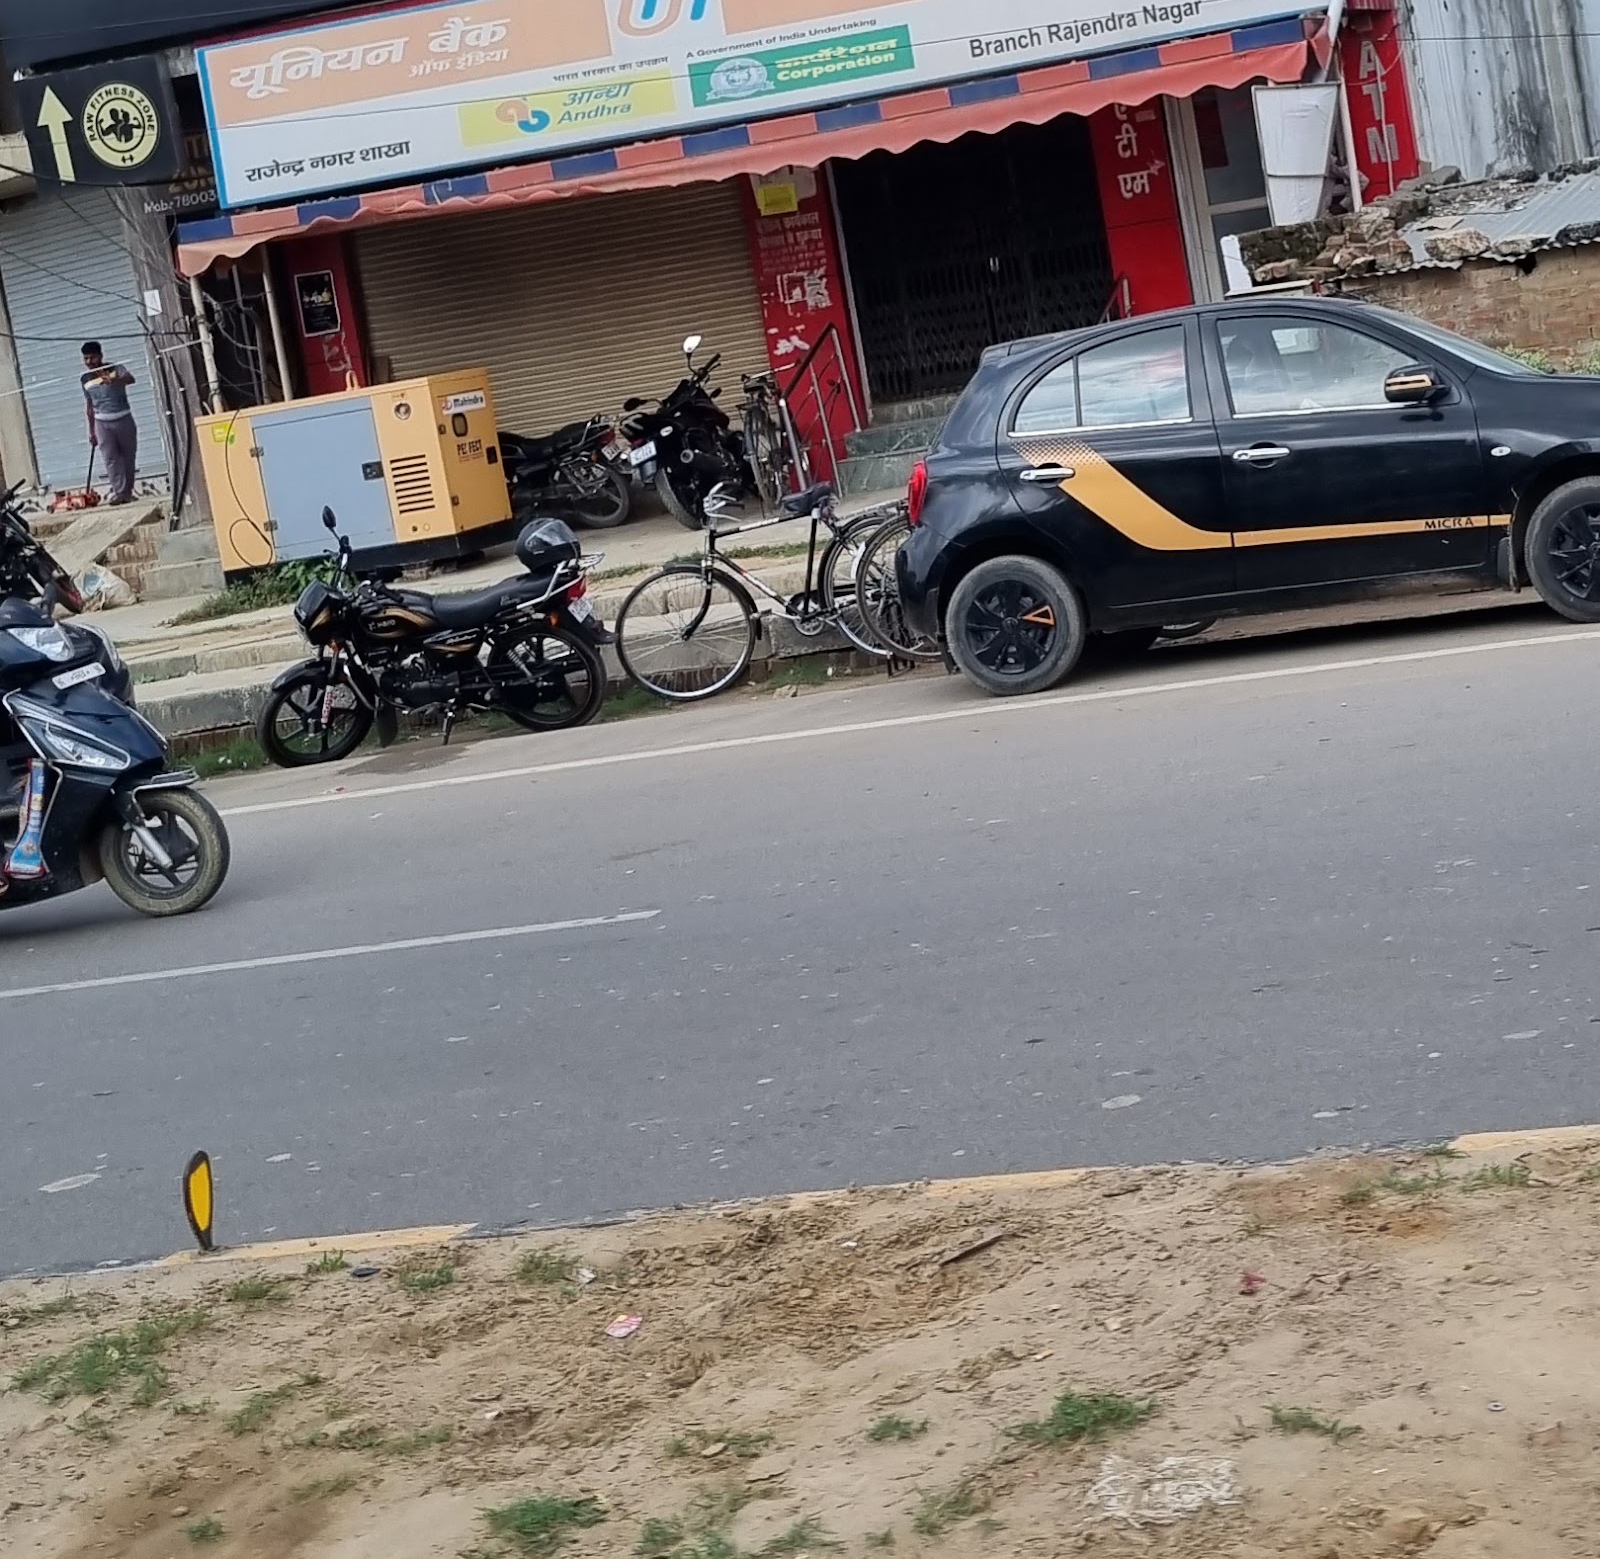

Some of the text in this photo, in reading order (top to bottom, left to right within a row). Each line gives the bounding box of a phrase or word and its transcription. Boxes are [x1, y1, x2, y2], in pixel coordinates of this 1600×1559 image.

[686, 18, 877, 59] A Government of India Undertaking
[969, 0, 1202, 58] Branch Rajendra Nagar
[230, 16, 511, 99] यूनियन बैंक
[776, 51, 896, 82] Corporation
[86, 87, 155, 142] RAW FITNESS ZONE
[557, 102, 632, 125] Andhra
[245, 140, 411, 182] राजेन्द्र नगर शाखा
[1424, 517, 1474, 529] MICRA
